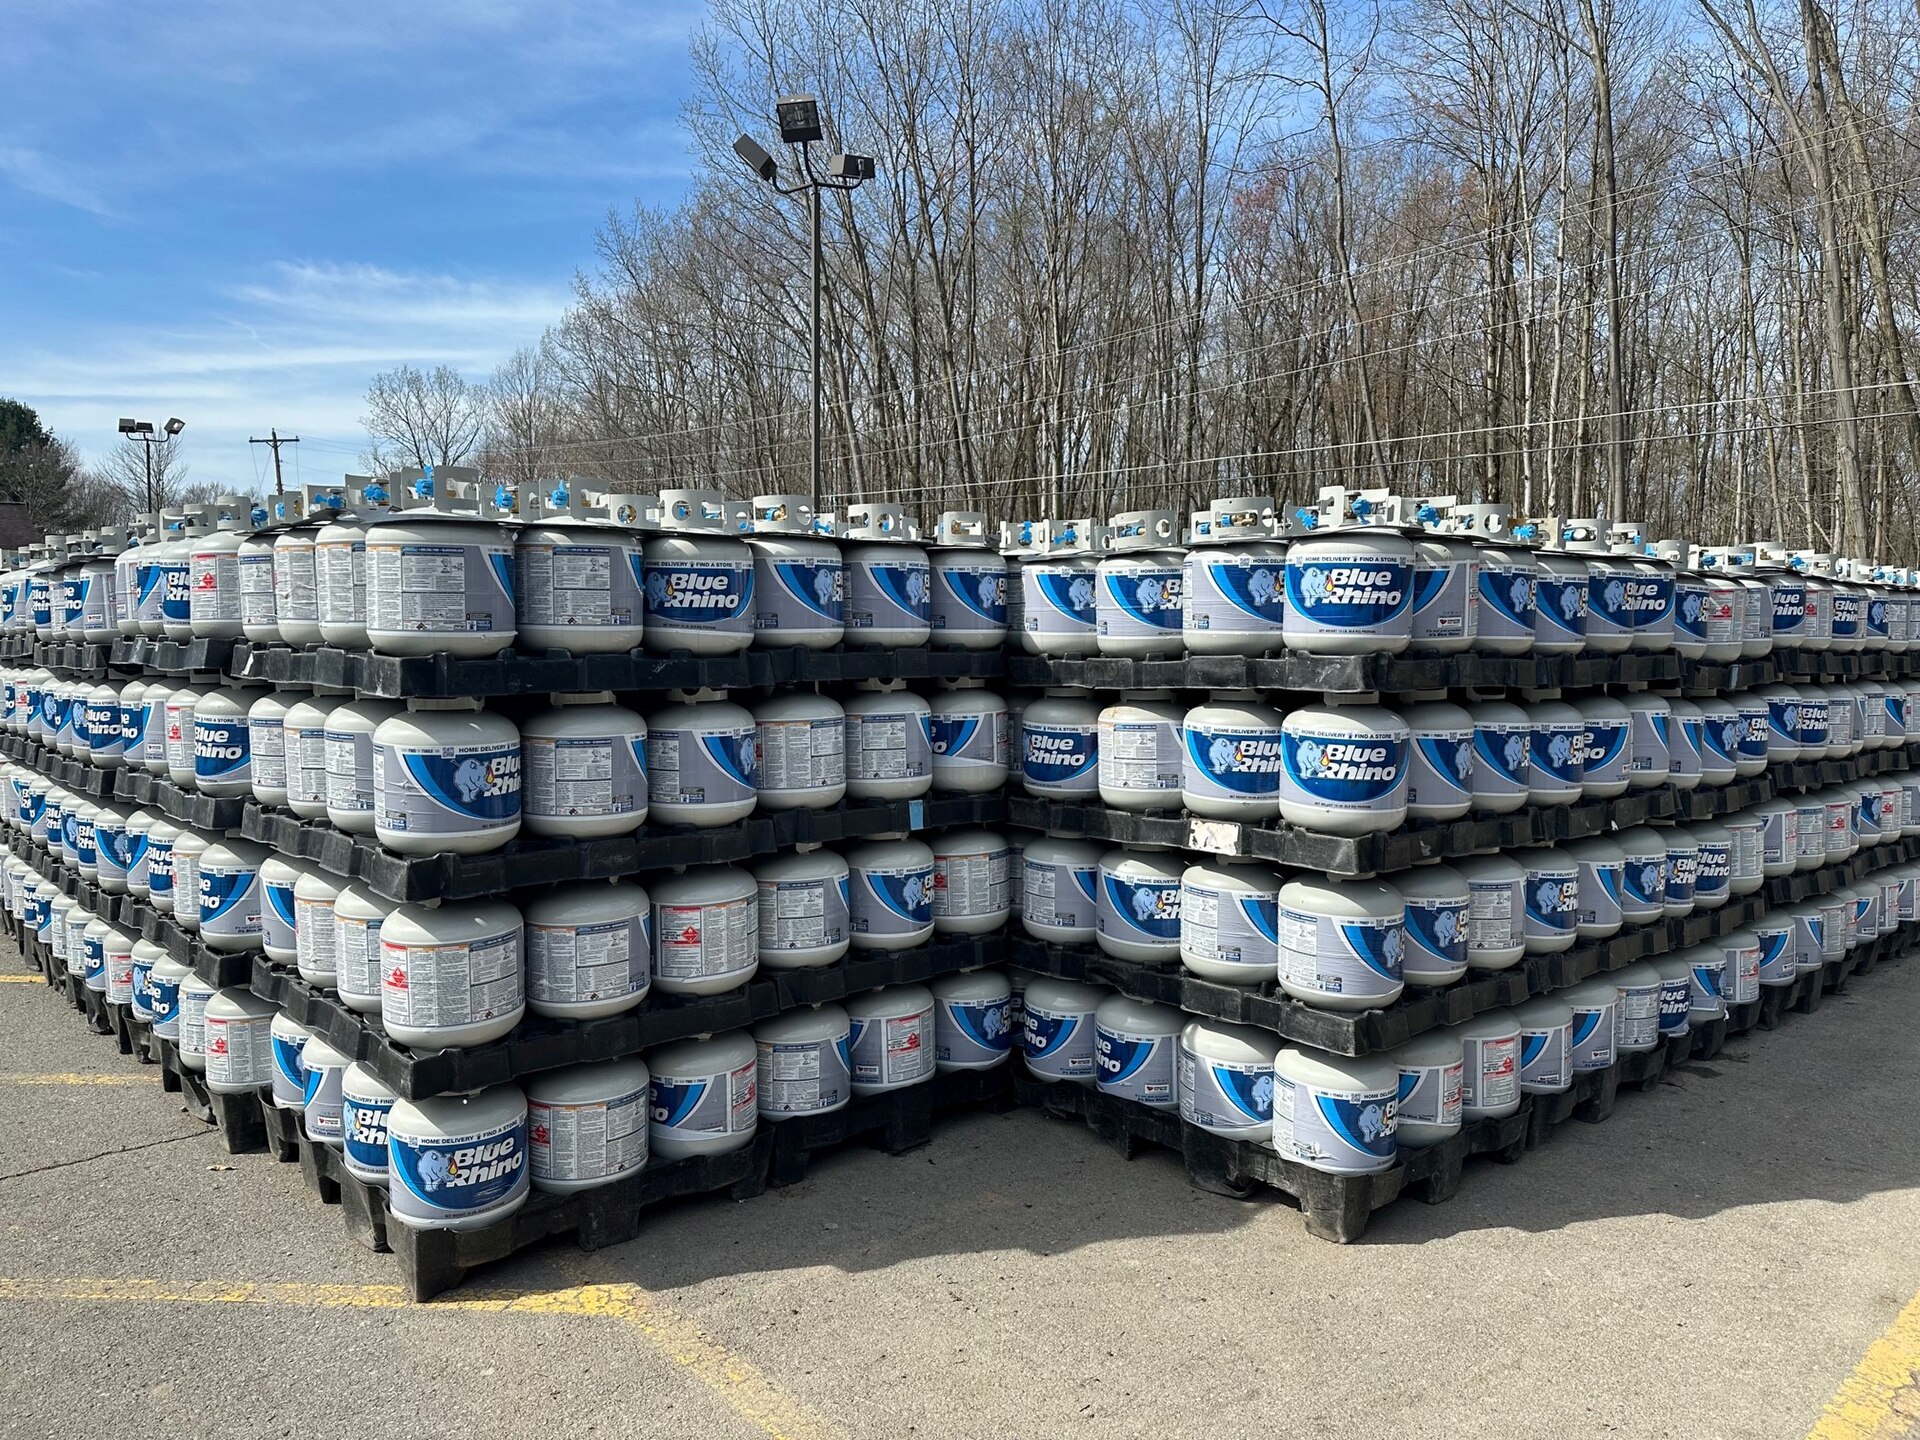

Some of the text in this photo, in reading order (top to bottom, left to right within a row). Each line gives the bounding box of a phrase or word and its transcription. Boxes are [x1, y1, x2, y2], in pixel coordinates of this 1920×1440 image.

[670, 573, 728, 590] Blue
[1331, 568, 1392, 586] Blue
[664, 591, 739, 608] Rhino
[1322, 587, 1401, 606] Rhino
[1773, 593, 1800, 604] lue
[1773, 604, 1804, 616] hino
[1031, 734, 1074, 750] Blue
[1028, 751, 1086, 766] Rhino
[1326, 744, 1387, 762] Blue
[1232, 757, 1280, 772] Rhin
[1318, 764, 1396, 781] Rhino
[1698, 865, 1730, 876] hino
[1660, 990, 1686, 1000] lue
[1660, 1001, 1689, 1014] hino
[442, 1136, 474, 1144] DELIVERY
[483, 1130, 496, 1138] FIND
[503, 1120, 518, 1131] STORE
[452, 1138, 514, 1167] Blue
[446, 1151, 522, 1188] Rhino
